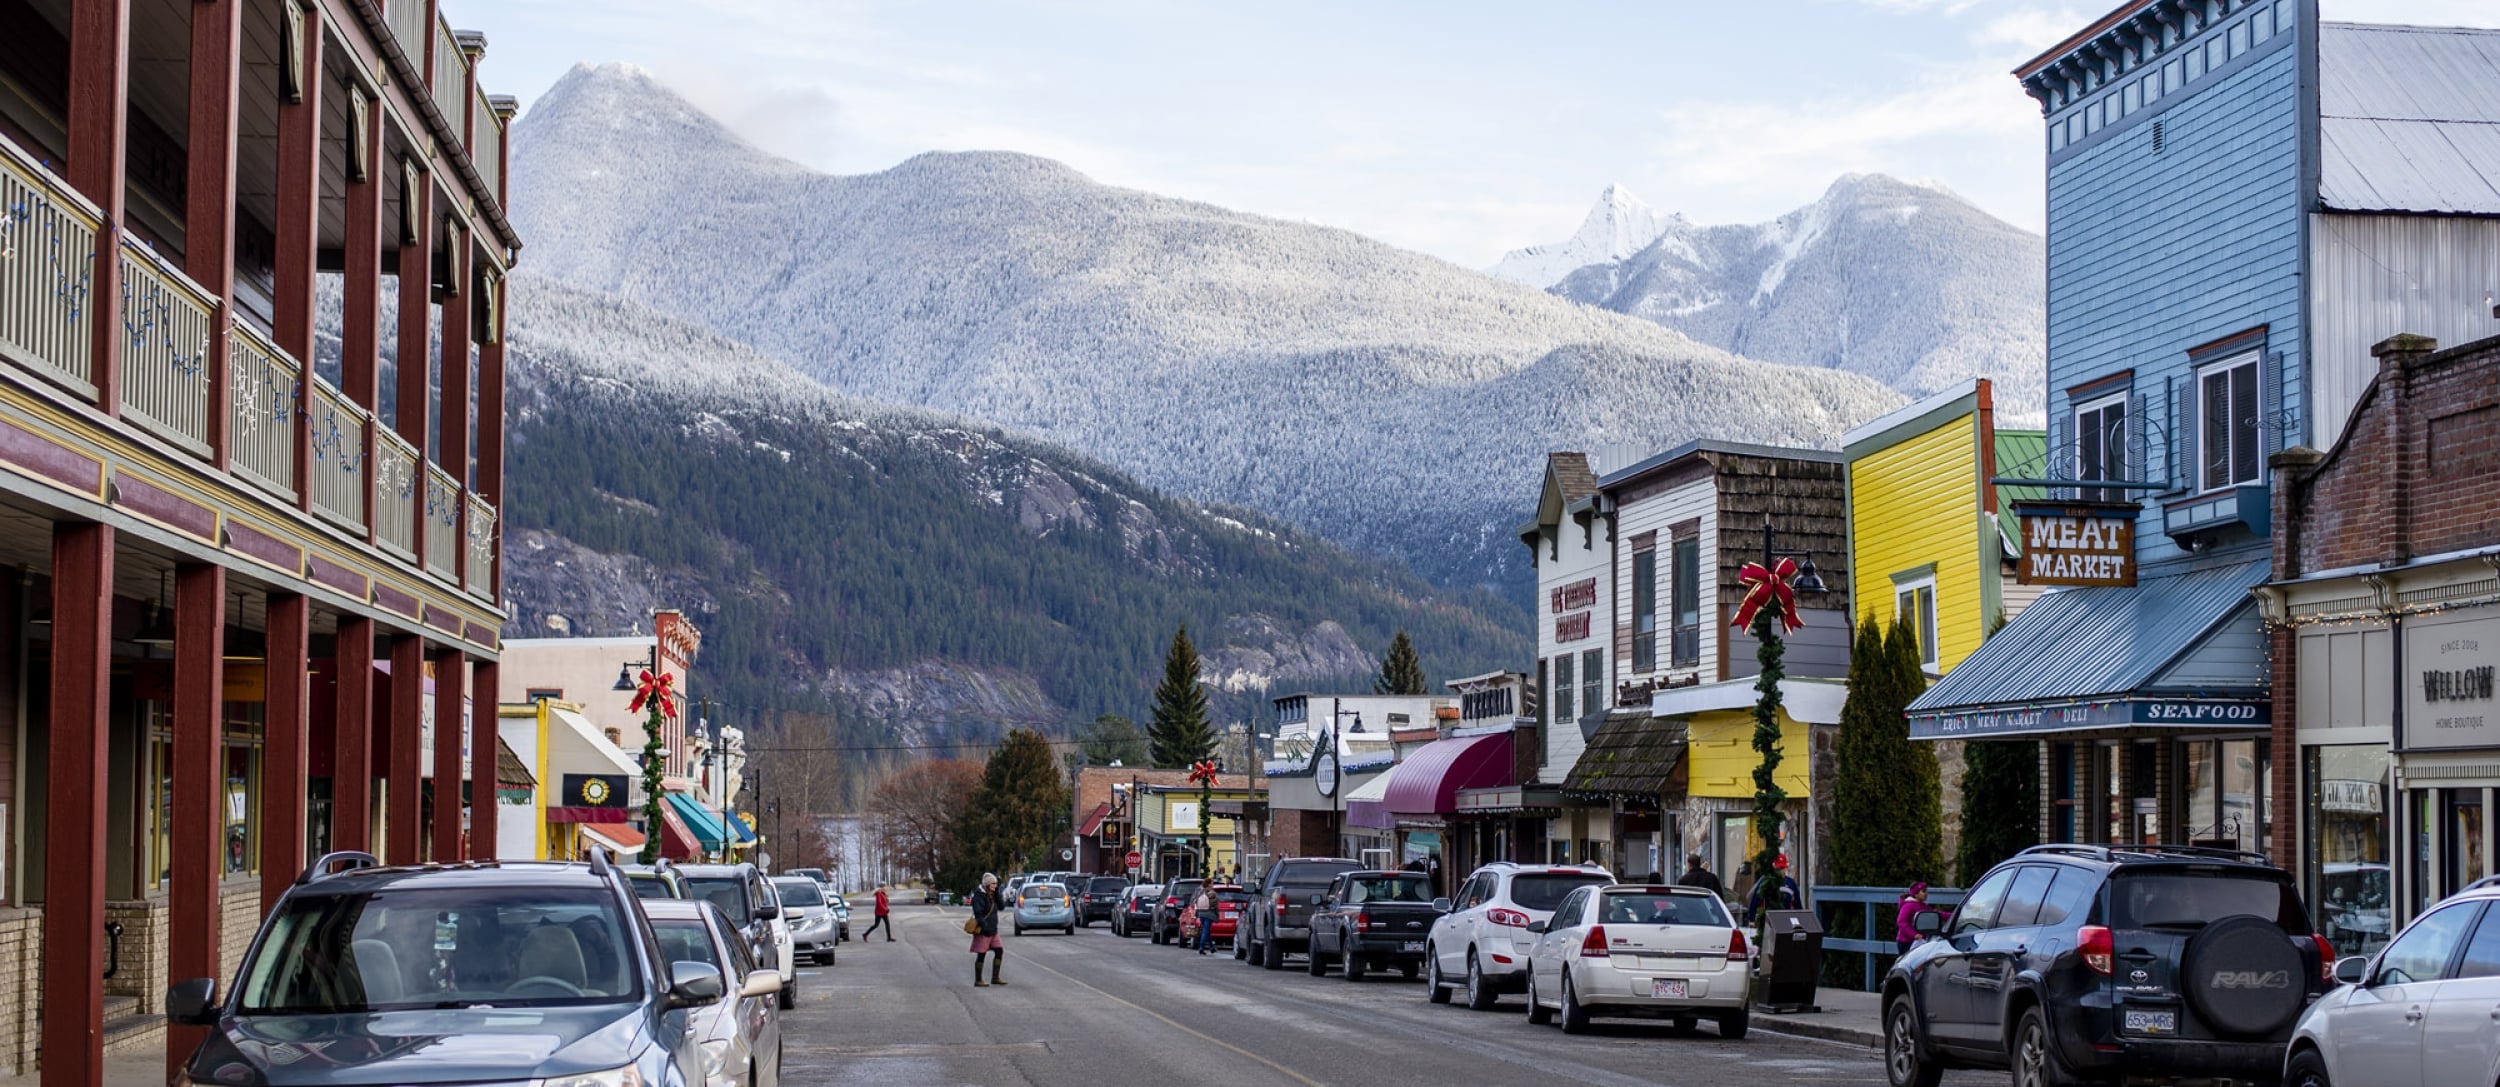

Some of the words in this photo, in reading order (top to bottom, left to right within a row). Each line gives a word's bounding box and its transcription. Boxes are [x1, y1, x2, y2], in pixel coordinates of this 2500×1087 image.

[2031, 517, 2124, 550] MEAT
[2031, 554, 2124, 579] MARKET
[2440, 640, 2460, 655] SINCE
[2462, 639, 2479, 652] 2008
[2423, 665, 2495, 702] WILLOW
[1462, 687, 1513, 720] PIZZERIA
[2147, 703, 2257, 719] SEAFOOD
[2063, 708, 2088, 723] DELI
[2435, 718, 2453, 729] HOME
[2455, 716, 2485, 730] BOUTIQUE
[1126, 856, 1142, 865] STOP
[2211, 970, 2290, 989] RAV4
